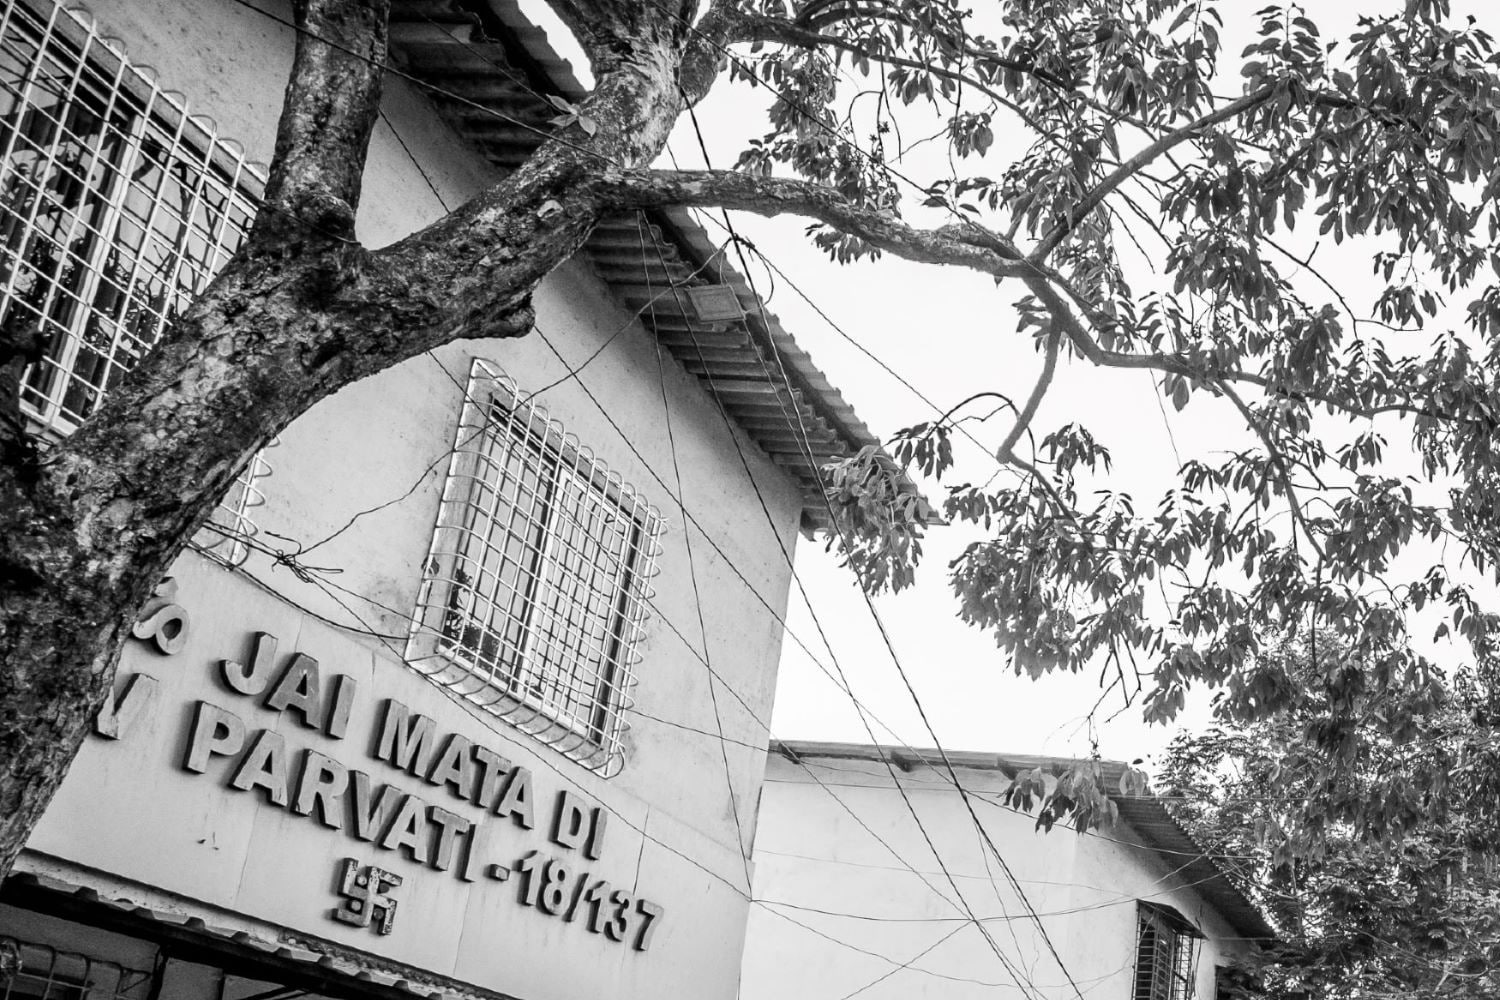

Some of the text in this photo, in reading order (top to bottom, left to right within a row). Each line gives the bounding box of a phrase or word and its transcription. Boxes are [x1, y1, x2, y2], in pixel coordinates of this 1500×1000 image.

[220, 631, 357, 739] JAI
[374, 697, 535, 830] MATA
[552, 789, 608, 861] DI
